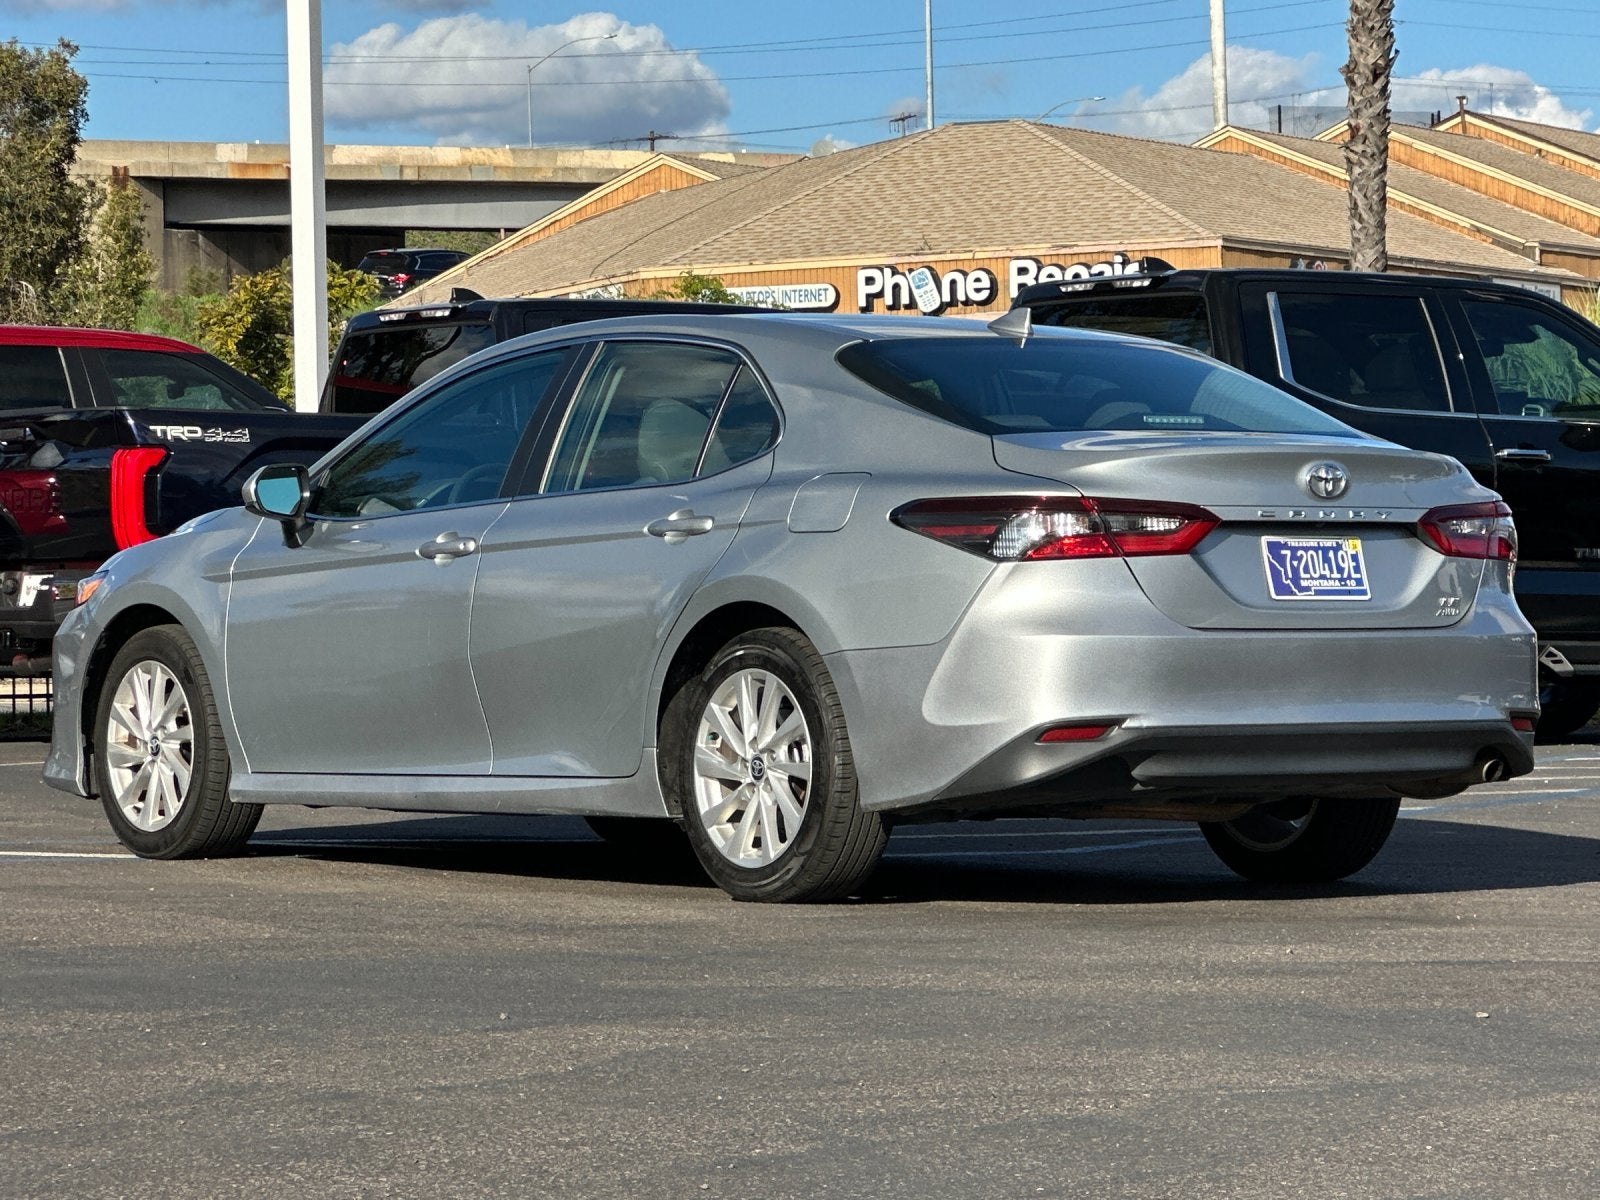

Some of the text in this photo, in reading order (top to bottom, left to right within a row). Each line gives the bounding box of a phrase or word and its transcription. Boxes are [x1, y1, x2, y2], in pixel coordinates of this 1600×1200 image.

[738, 287, 829, 304] APTOPS INTERNET
[149, 425, 202, 441] TRD
[1257, 510, 1393, 519] CAMRY
[1300, 579, 1341, 587] MONTANA
